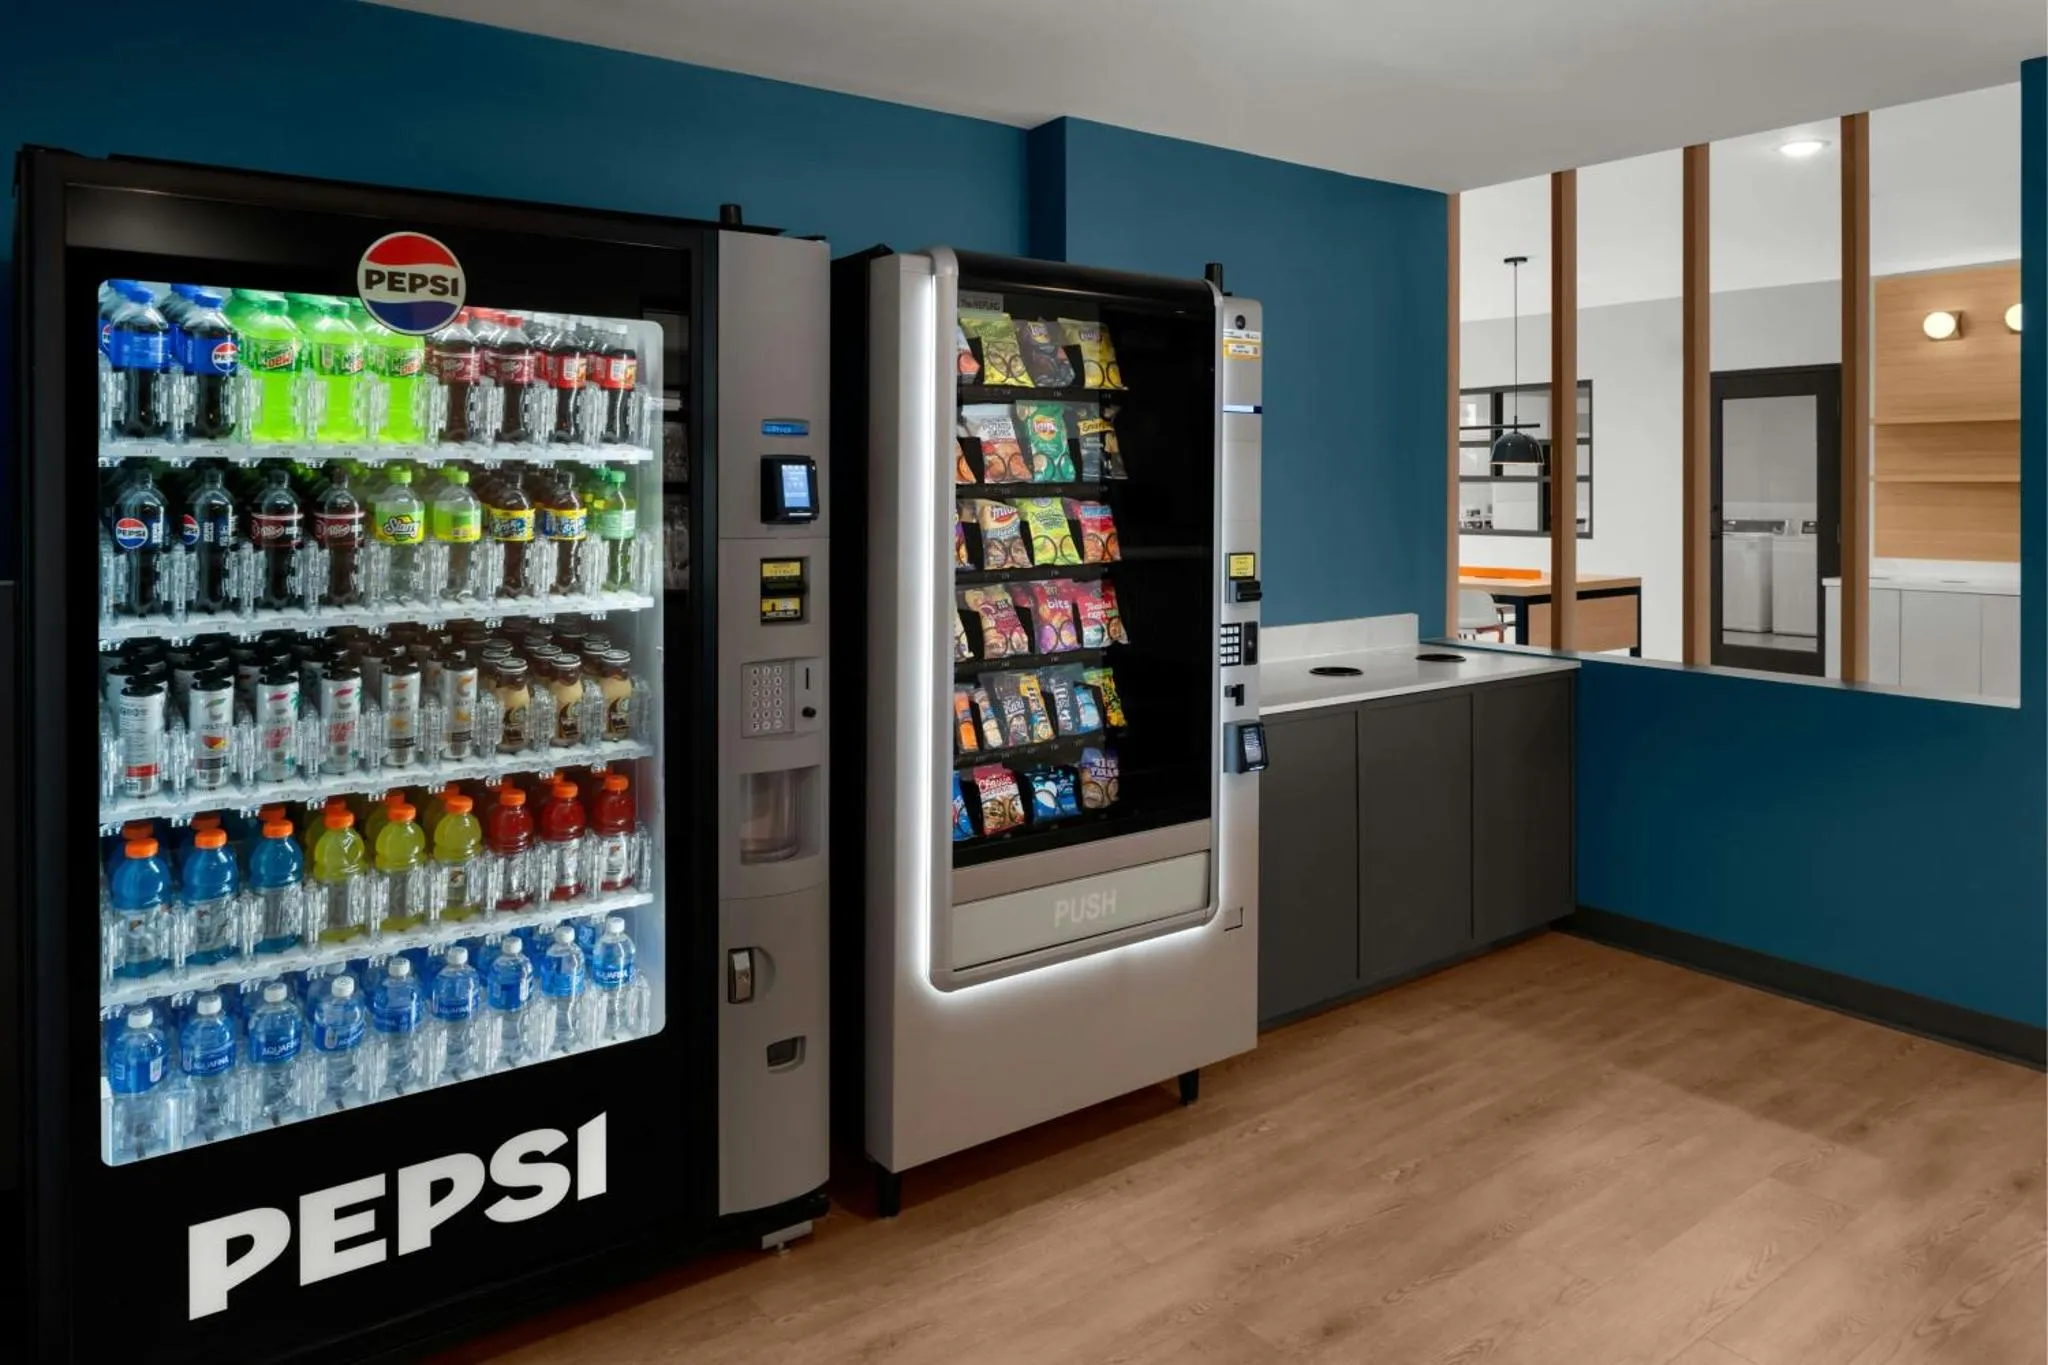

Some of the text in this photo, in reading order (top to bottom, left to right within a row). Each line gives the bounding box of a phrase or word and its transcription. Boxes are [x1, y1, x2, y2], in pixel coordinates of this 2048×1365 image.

[364, 269, 459, 297] PEPSI
[116, 528, 146, 538] PEPSI
[1054, 889, 1117, 928] PUSH
[189, 1111, 606, 1321] PEPSI
